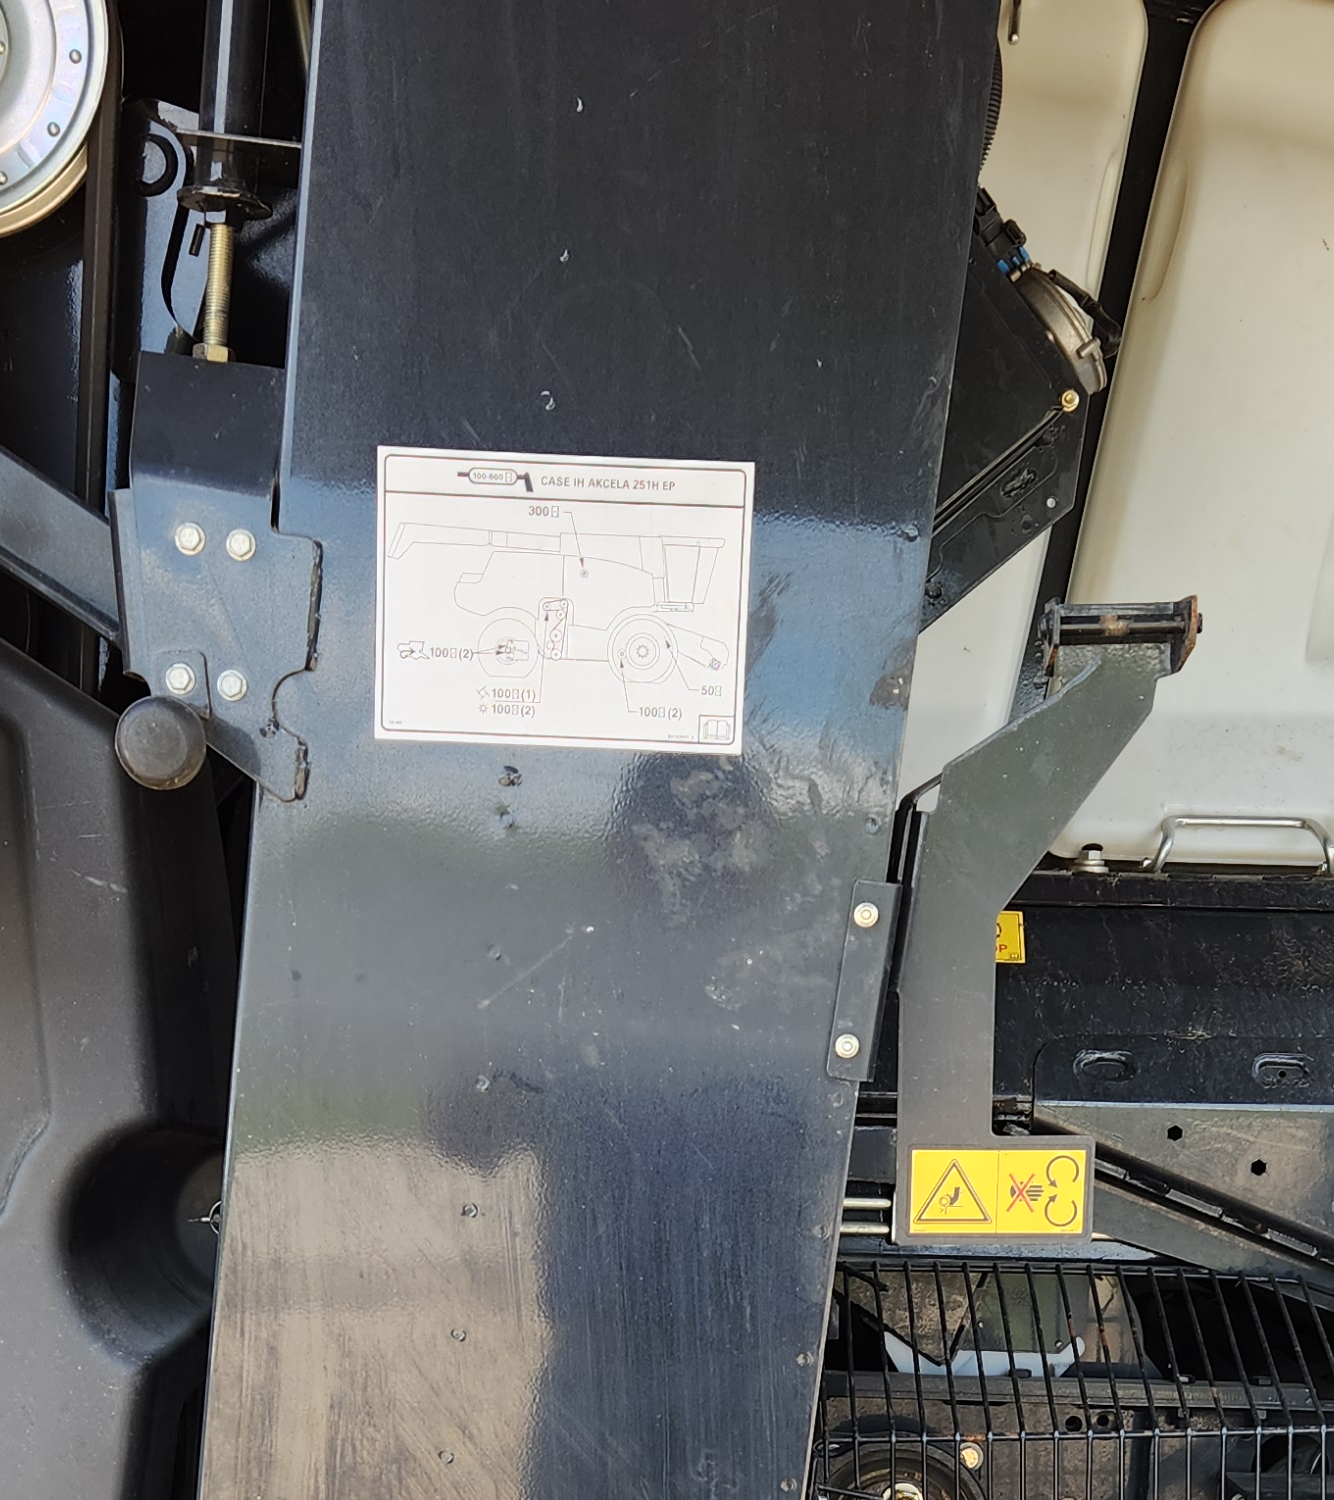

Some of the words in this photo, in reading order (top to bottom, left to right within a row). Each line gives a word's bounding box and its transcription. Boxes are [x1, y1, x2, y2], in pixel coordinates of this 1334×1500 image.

[540, 475, 571, 487] CASE
[573, 477, 585, 488] IH
[587, 477, 630, 490] AKCELA
[632, 479, 659, 491] 251H
[662, 480, 676, 492] EP
[528, 505, 550, 517] 300
[430, 647, 449, 658] 100
[458, 648, 474, 661] (2)
[491, 688, 511, 698] 100
[701, 685, 715, 695] 50
[491, 704, 511, 714] 100
[521, 705, 536, 718] (2)
[639, 707, 658, 717] 100
[668, 707, 682, 721] (2)
